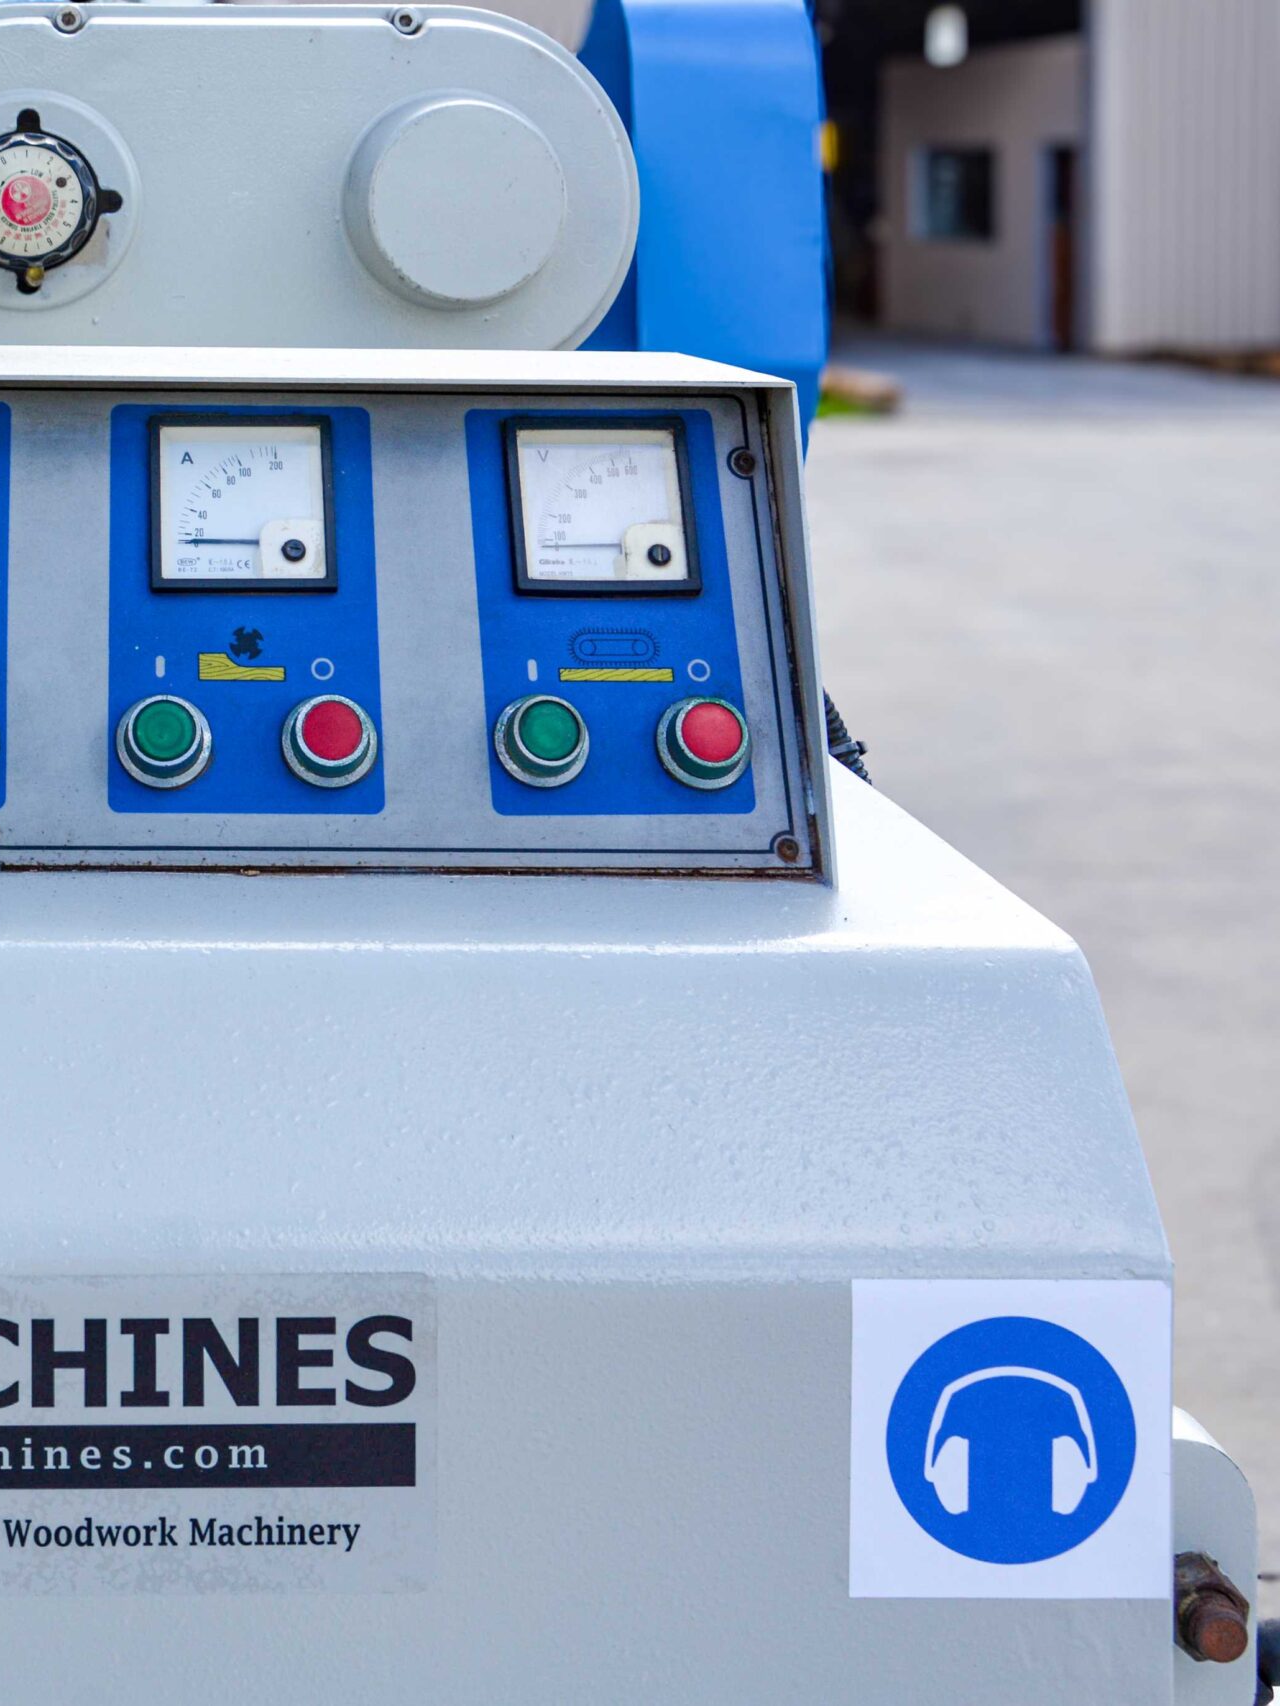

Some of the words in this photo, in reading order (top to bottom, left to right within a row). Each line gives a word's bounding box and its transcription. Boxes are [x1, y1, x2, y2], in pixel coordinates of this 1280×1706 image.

[181, 451, 194, 465] A
[536, 449, 550, 463] V
[269, 460, 284, 471] 200
[238, 467, 252, 478] 100
[226, 475, 236, 486] 80
[589, 474, 603, 485] 400
[211, 488, 222, 499] 60
[197, 510, 208, 520] 40
[194, 527, 205, 538] 20
[2, 1515, 179, 1548] Woodwork
[188, 1514, 362, 1553] Machinery
